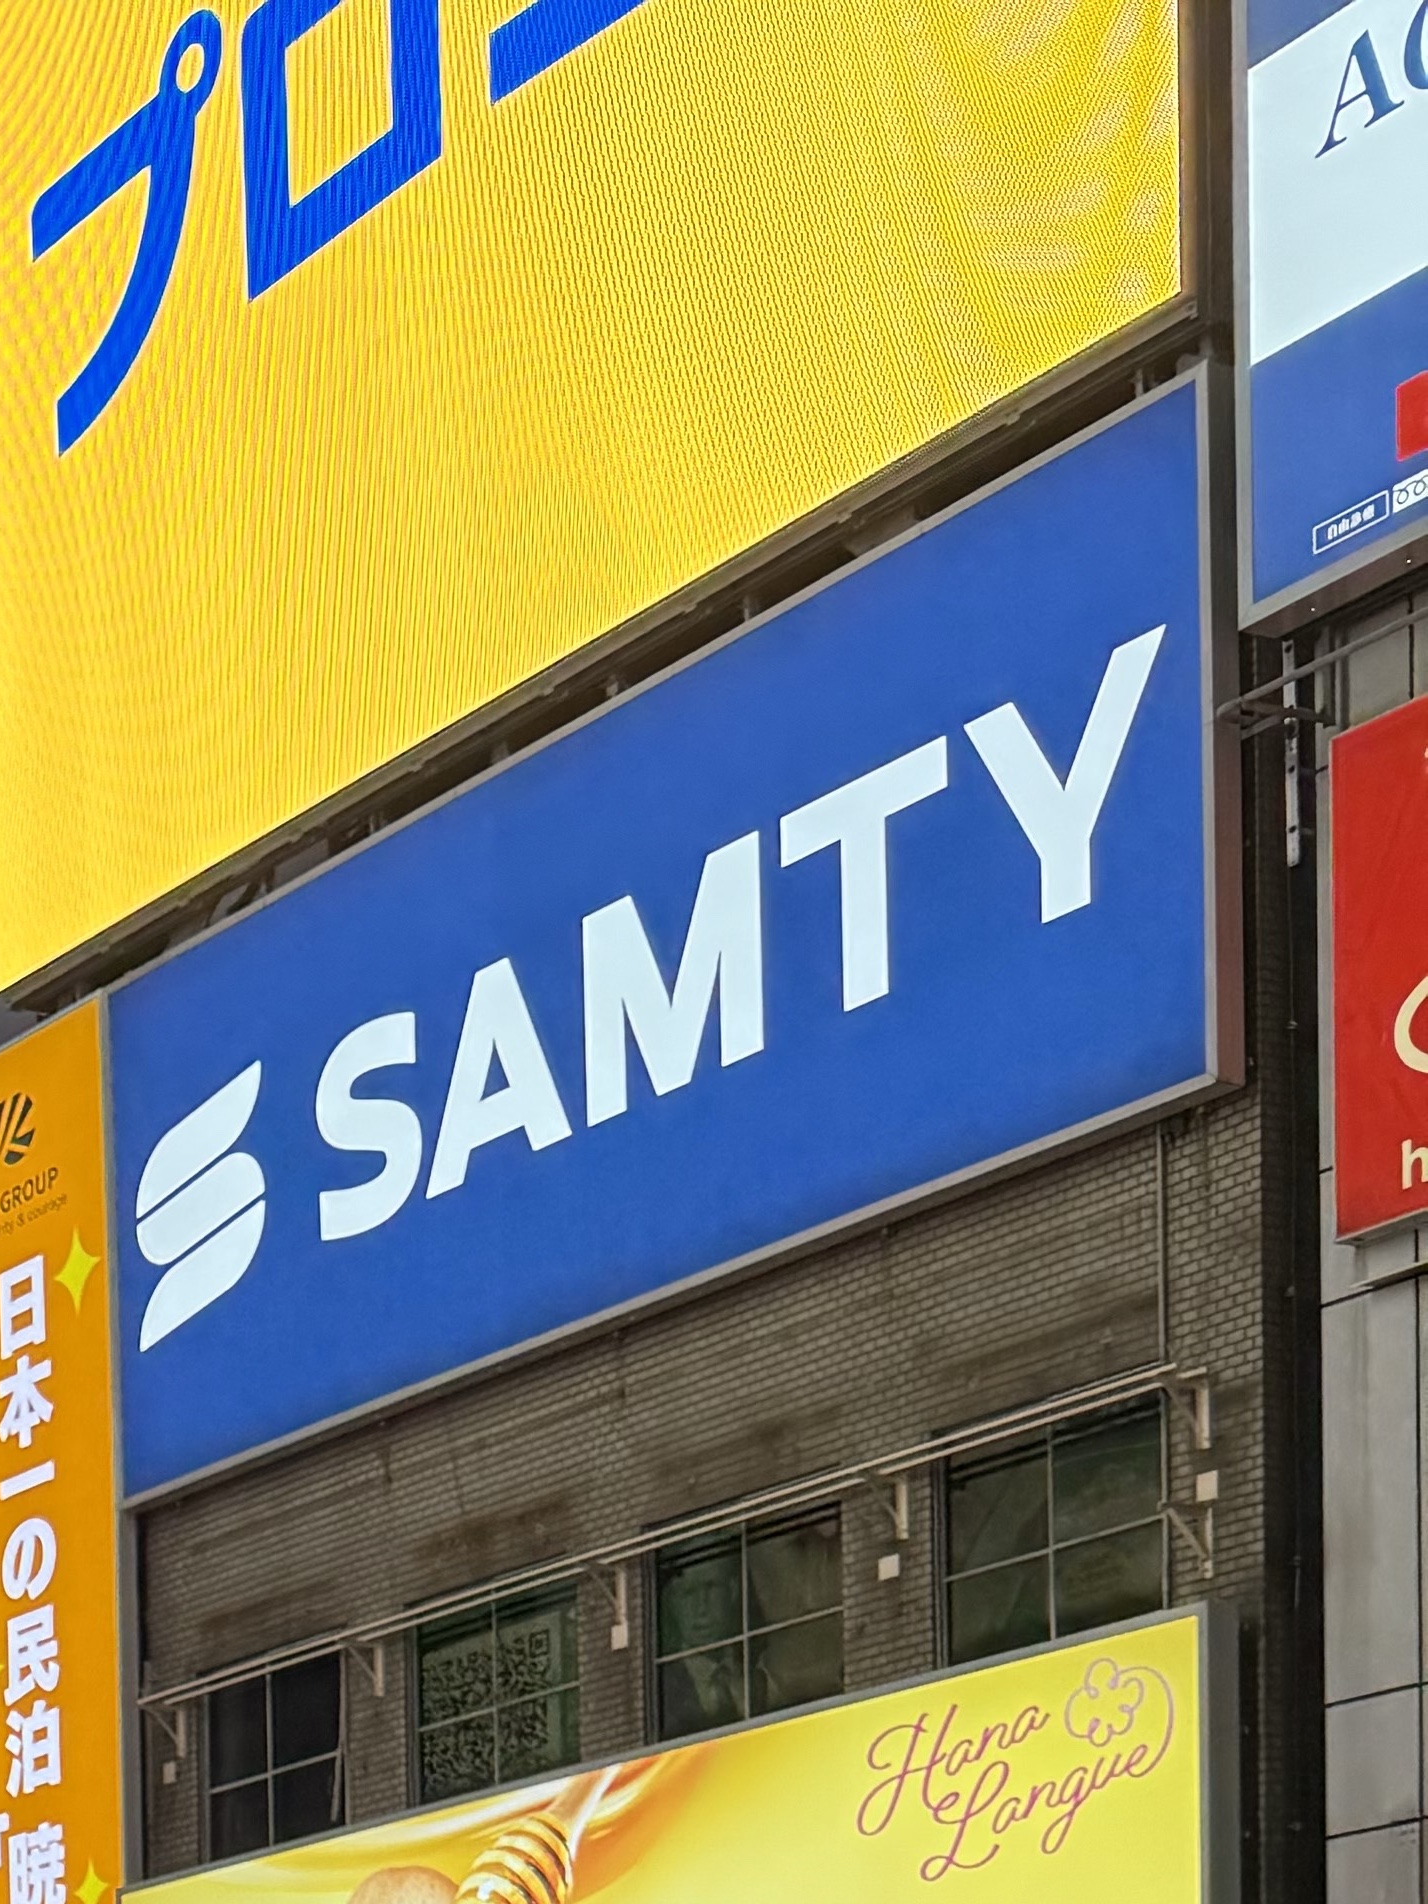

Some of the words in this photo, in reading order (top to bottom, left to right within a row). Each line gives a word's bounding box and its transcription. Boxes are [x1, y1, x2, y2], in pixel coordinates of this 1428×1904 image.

[317, 624, 1168, 1241] SAMTY
[0, 1166, 59, 1213] GROUP
[856, 1703, 1051, 1838] Hana
[918, 1742, 1154, 1883] Langue
